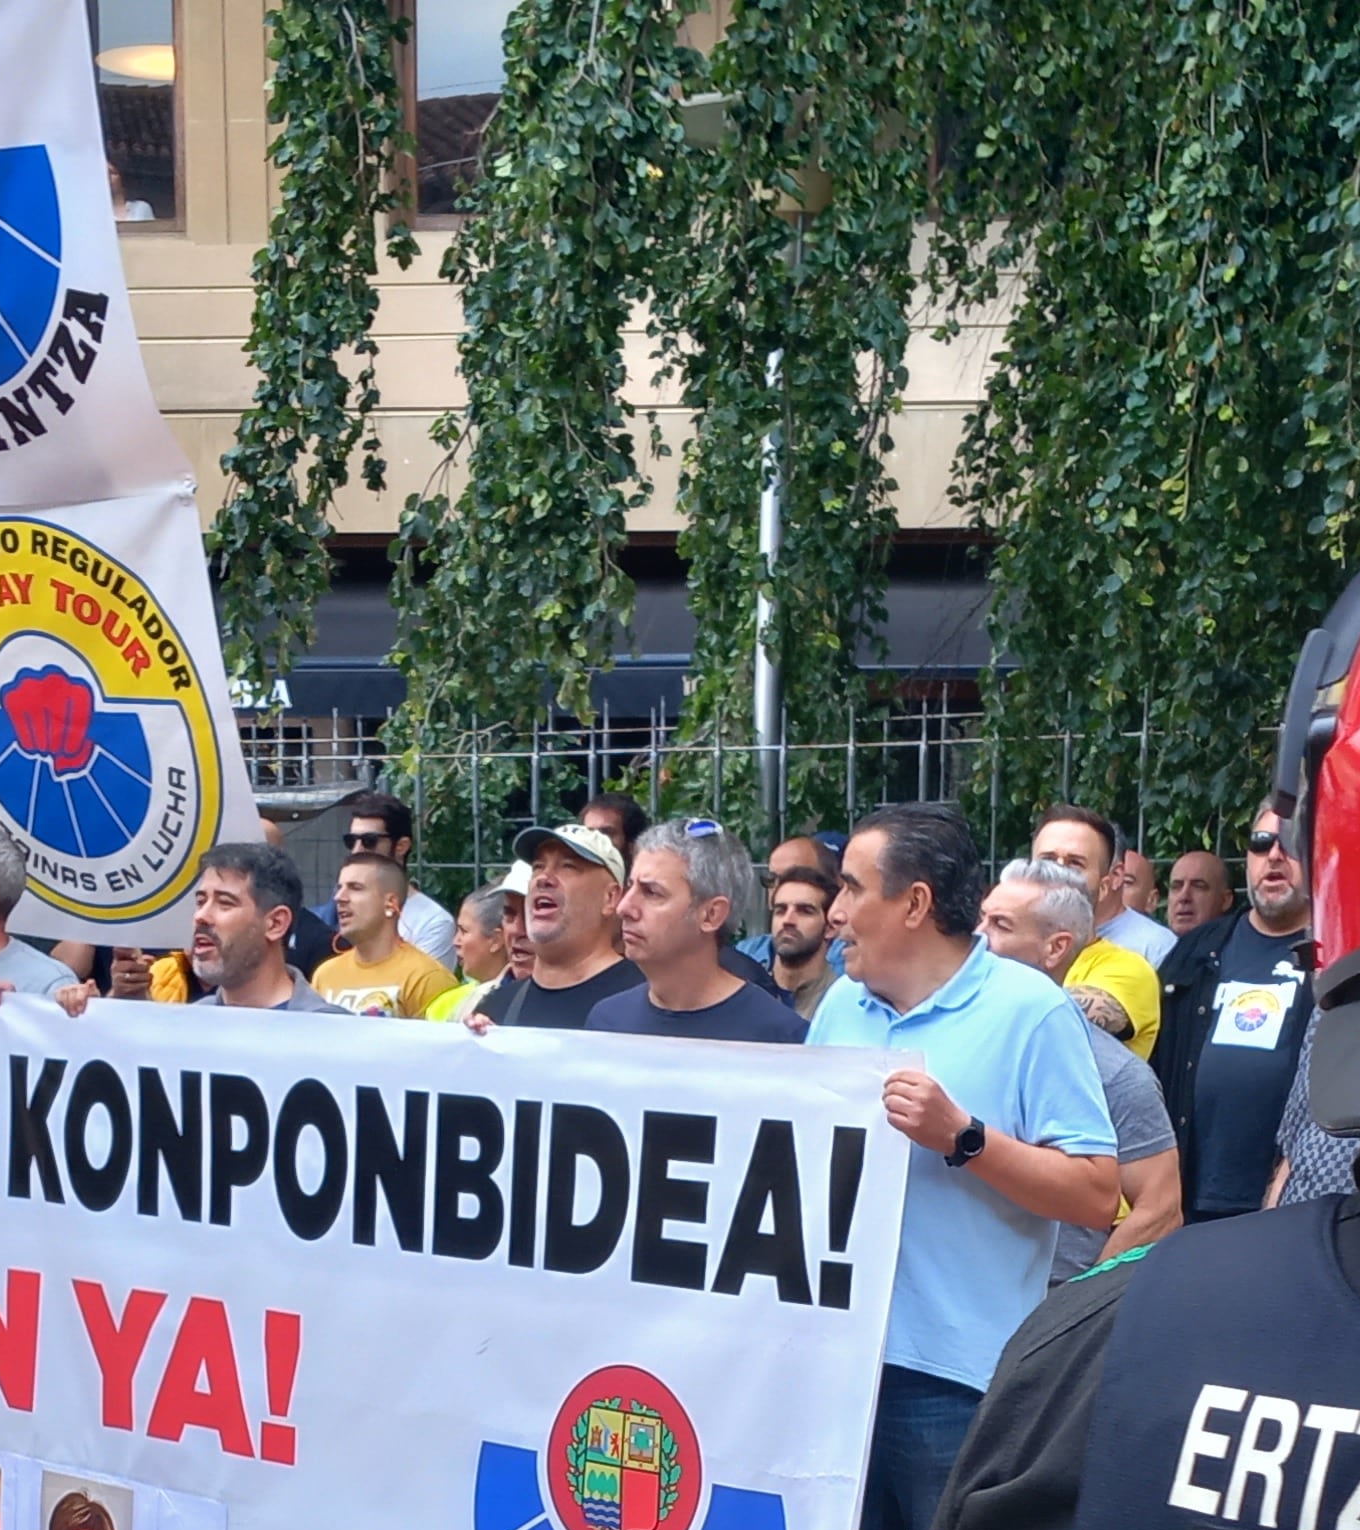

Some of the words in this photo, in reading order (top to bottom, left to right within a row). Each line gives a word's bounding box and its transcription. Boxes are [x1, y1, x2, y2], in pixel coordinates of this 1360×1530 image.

[31, 529, 191, 692] REGULADOR
[50, 578, 151, 679] TOUR
[105, 864, 144, 892] EN
[143, 766, 187, 872] LUCHA
[8, 1055, 867, 1309] KONPONBIDEA!
[72, 1278, 301, 1465] YA!
